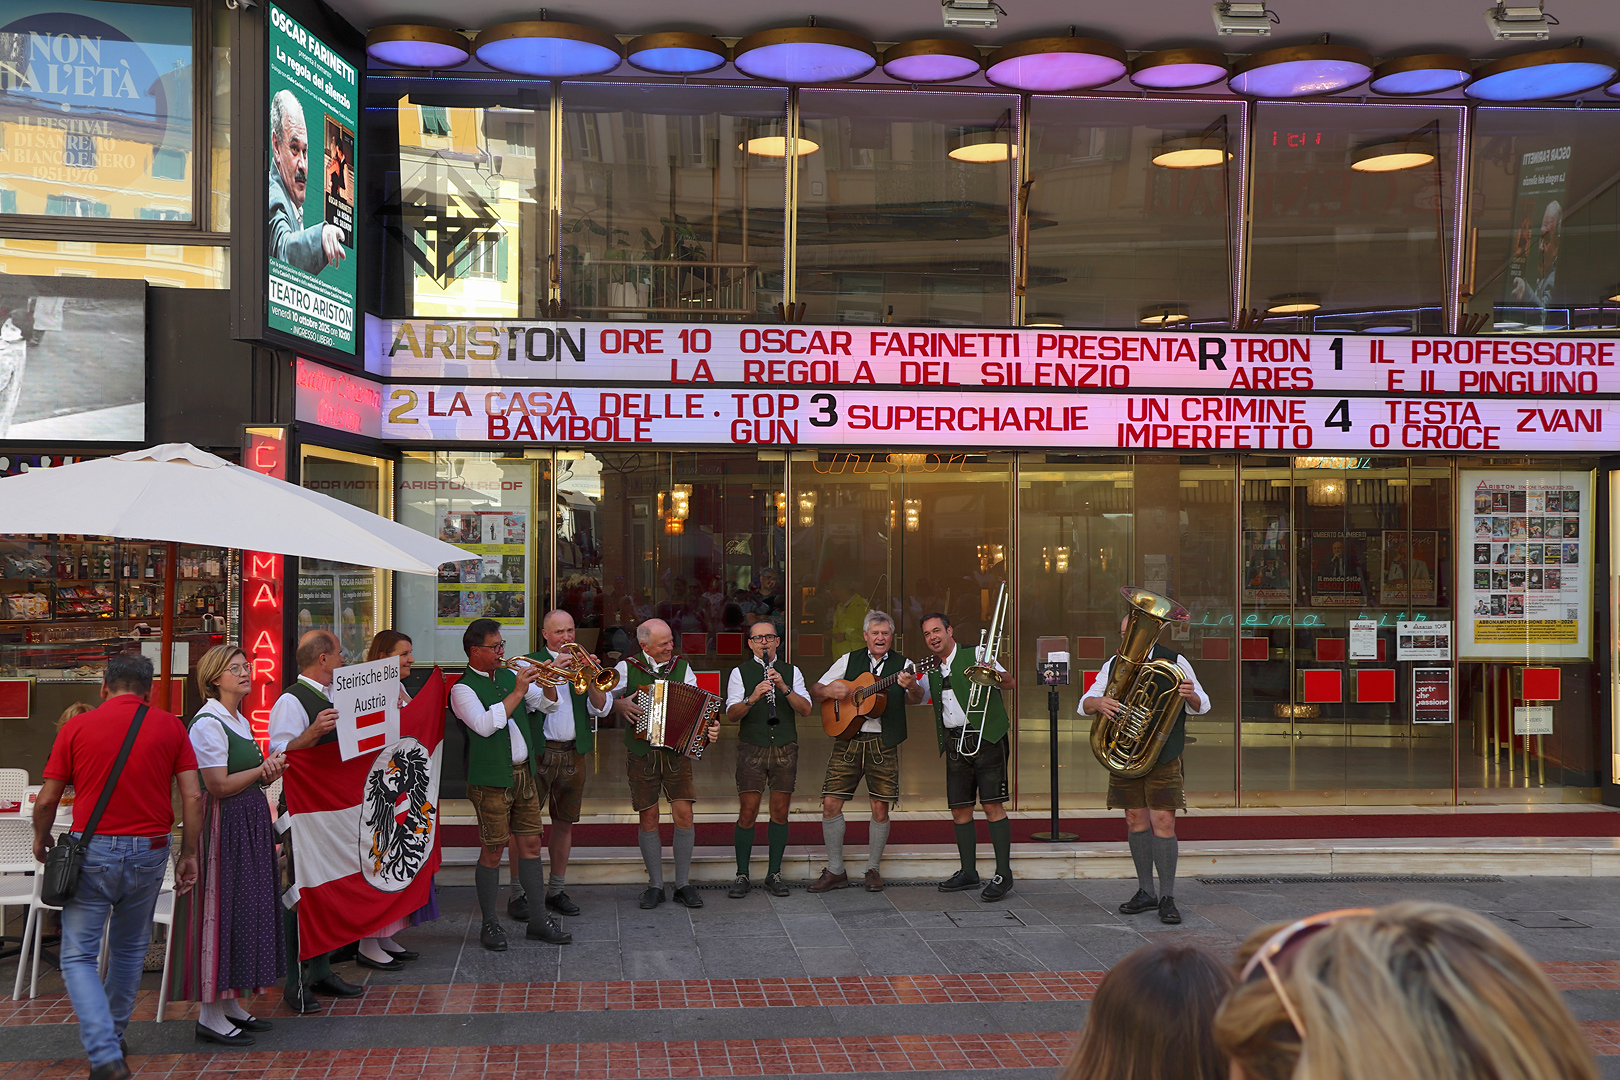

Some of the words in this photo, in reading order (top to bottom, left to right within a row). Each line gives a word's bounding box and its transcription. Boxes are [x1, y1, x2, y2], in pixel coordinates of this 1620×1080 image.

[28, 31, 102, 65] NON
[272, 7, 307, 48] OSCAR
[308, 35, 354, 86] FARINETTI
[0, 61, 43, 93] HA
[48, 59, 140, 99] L'ETÀ
[276, 45, 286, 63] La
[287, 56, 311, 82] regola
[312, 73, 324, 91] del
[325, 82, 350, 110] silenzio
[18, 116, 36, 131] IL
[37, 118, 112, 136] FESTIVAL
[15, 132, 33, 147] DI
[36, 134, 116, 152] SANREMO
[14, 149, 75, 166] BIANCO
[92, 153, 135, 169] NERO
[33, 167, 98, 183] 1951-1976
[271, 280, 310, 310] TEATRO
[313, 298, 352, 327] ARISTON
[292, 312, 298, 322] 10
[299, 314, 318, 329] ottobre
[319, 321, 330, 333] 2025
[293, 325, 317, 341] INGRESSO
[317, 333, 332, 346] LIBERO
[388, 323, 585, 362] ARISTON
[600, 329, 663, 354] ORE
[678, 329, 712, 354] 10
[740, 330, 852, 356] OSCAR
[870, 331, 1020, 358] FARINETTI
[1037, 334, 1196, 362] PRESENTA
[1199, 338, 1226, 370] R
[1230, 338, 1310, 362] TRON
[1328, 338, 1343, 370] 1
[1370, 340, 1394, 364] IL
[1412, 340, 1615, 366] PROFESSORE
[671, 358, 715, 383] LA
[744, 360, 876, 385] REGOLA
[900, 361, 960, 386] DEL
[981, 362, 1130, 389] SILENZIO
[1229, 366, 1314, 391] ARES
[1388, 370, 1405, 393] E
[1421, 370, 1445, 394] IL
[1460, 371, 1598, 395] PINGUINO
[388, 390, 418, 424] 2
[428, 391, 473, 417] LA
[485, 391, 577, 417] CASA
[732, 394, 799, 418] TOP
[809, 393, 838, 427] 3
[847, 405, 1089, 432] SUPERCHARLIE
[1127, 398, 1167, 422] UN
[1182, 398, 1306, 424] CRIMINE
[1324, 400, 1352, 432] 4
[1385, 401, 1481, 425] TESTA
[1517, 409, 1602, 433] ZVANI
[487, 415, 652, 442] BAMBOLE
[731, 419, 798, 444] GUN
[1118, 423, 1312, 449] IMPERFETTO
[1370, 424, 1389, 448] O
[1402, 424, 1500, 450] CROCE
[400, 481, 472, 490] ARISTON
[474, 481, 523, 491] ROOF
[252, 445, 276, 607] CMA
[1190, 612, 1325, 626] inema
[337, 669, 382, 691] Steirische
[384, 665, 398, 680] Blas
[354, 693, 386, 713] Austria
